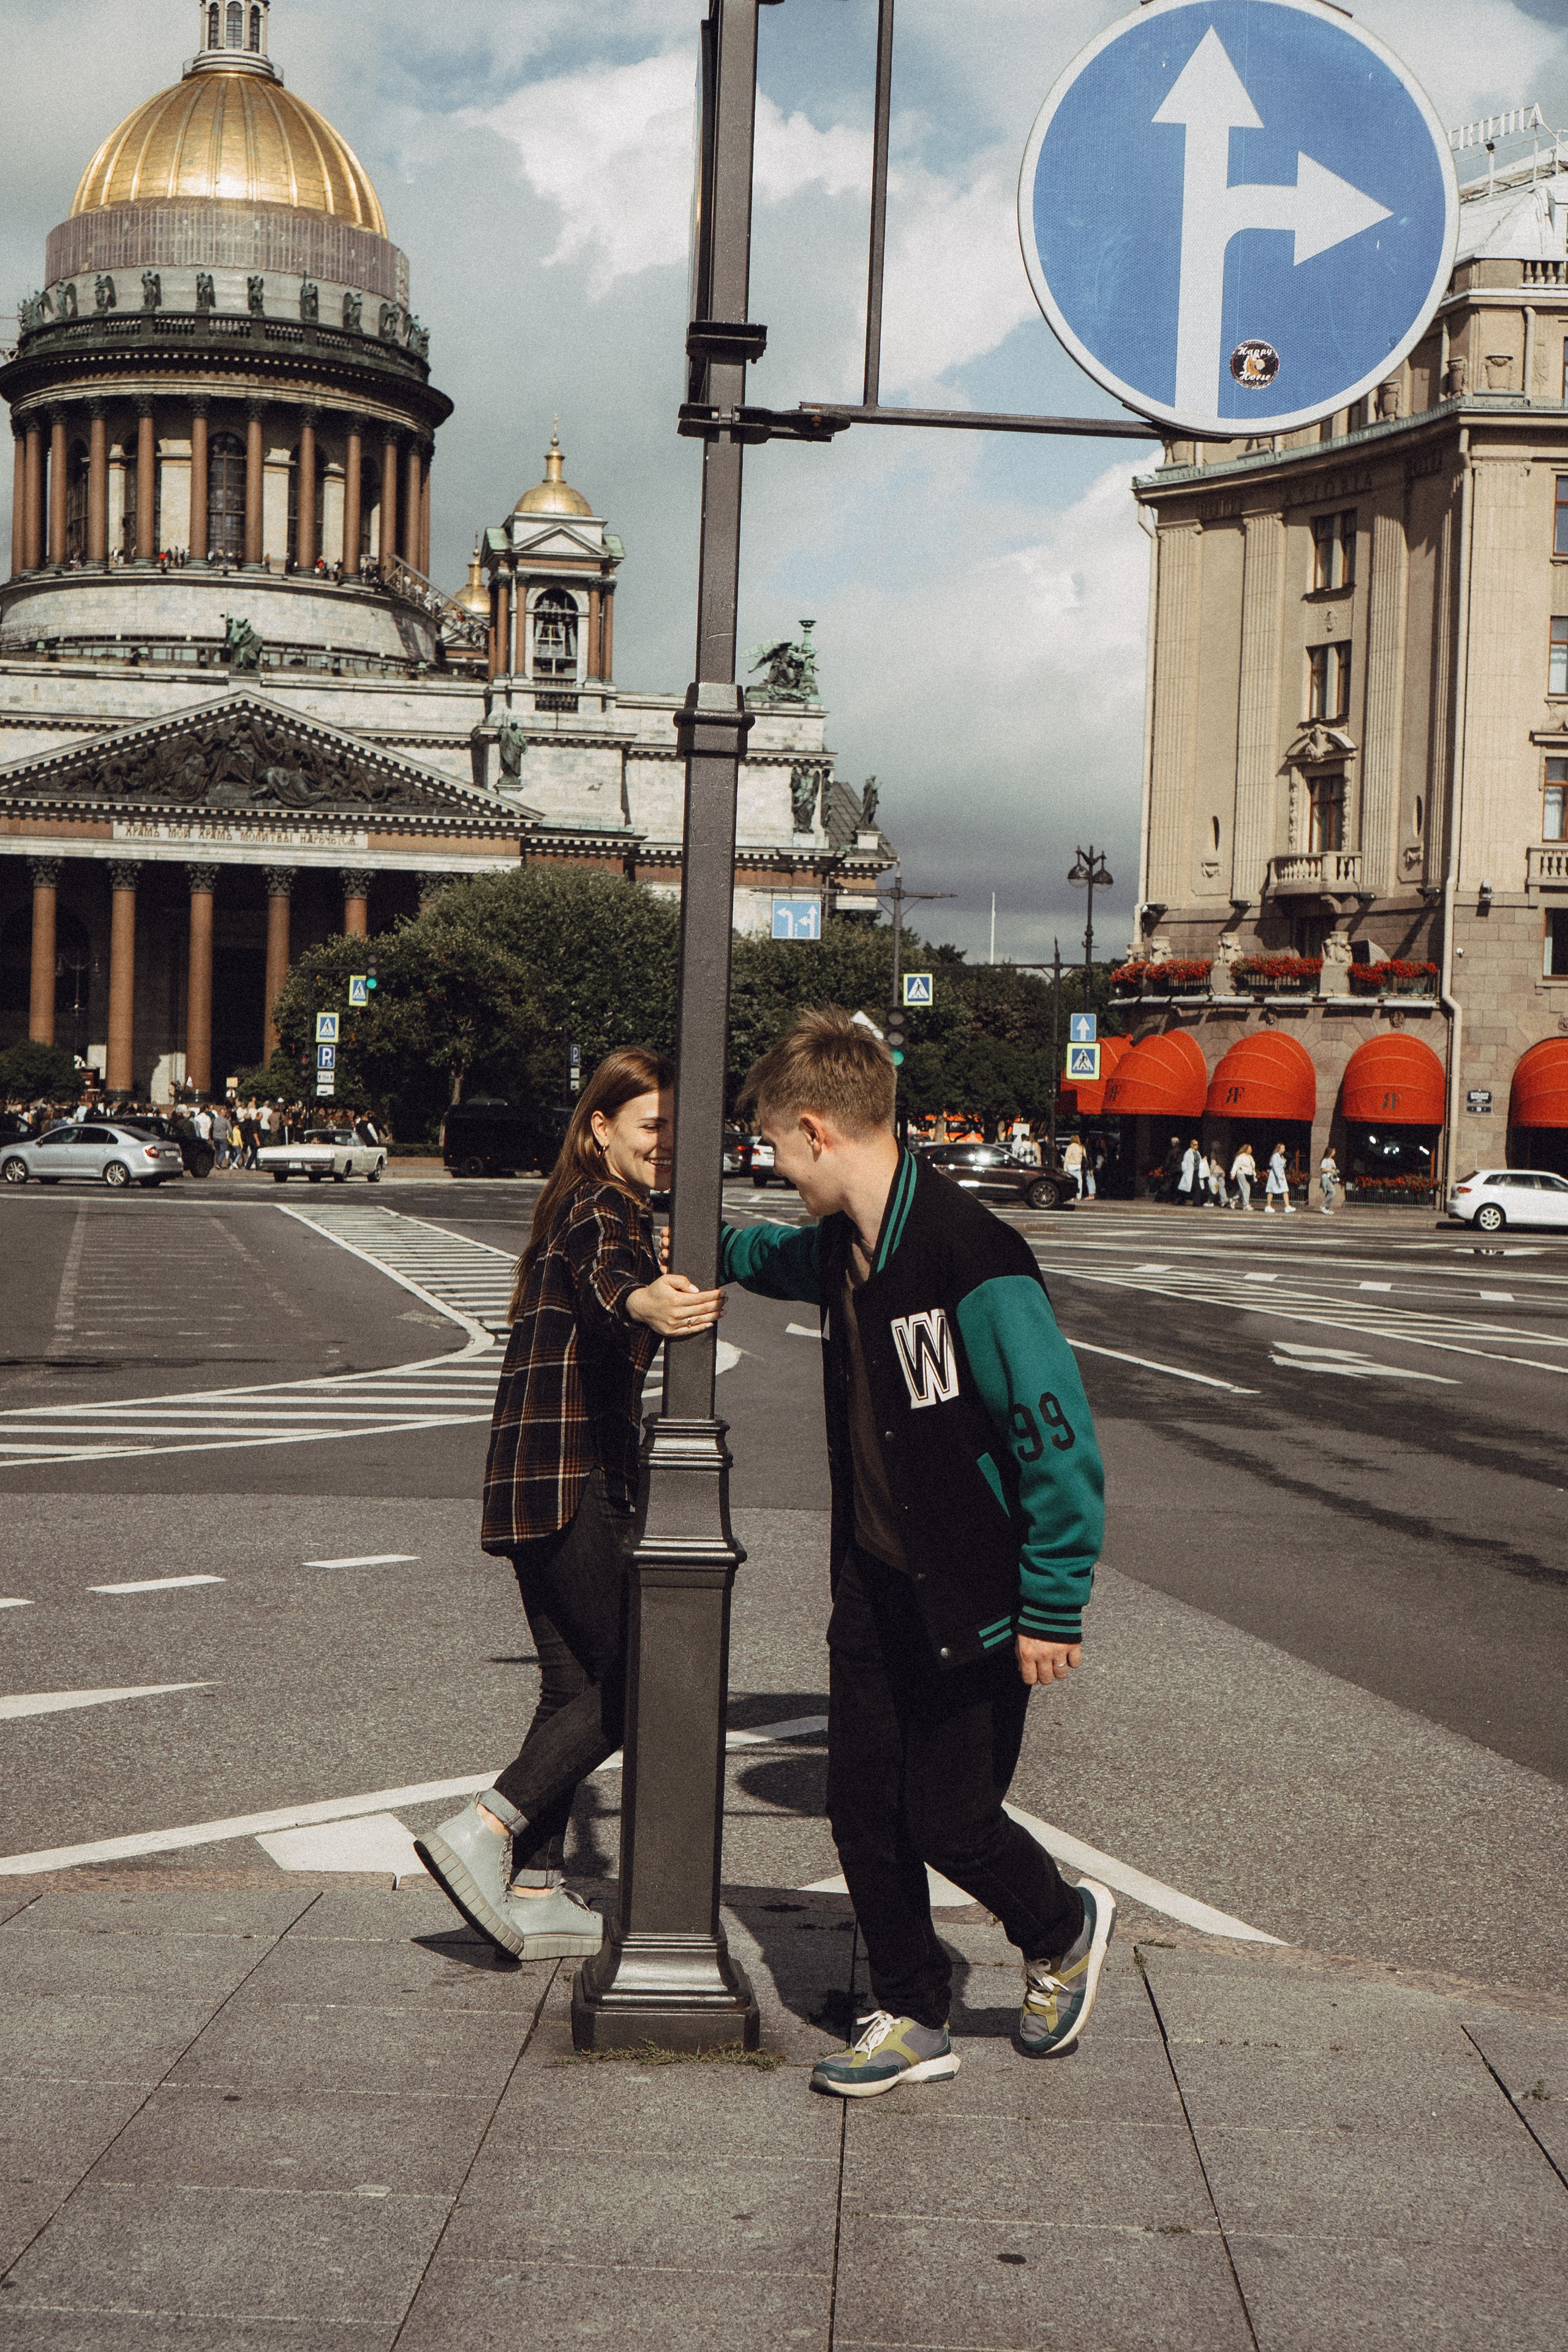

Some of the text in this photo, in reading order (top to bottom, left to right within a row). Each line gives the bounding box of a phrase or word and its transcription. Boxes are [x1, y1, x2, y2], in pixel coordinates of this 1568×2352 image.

[1237, 347, 1272, 357] Happy
[1239, 371, 1271, 380] Horse
[322, 1047, 332, 1066] P
[893, 1313, 954, 1405] W
[1011, 1391, 1076, 1463] 99
